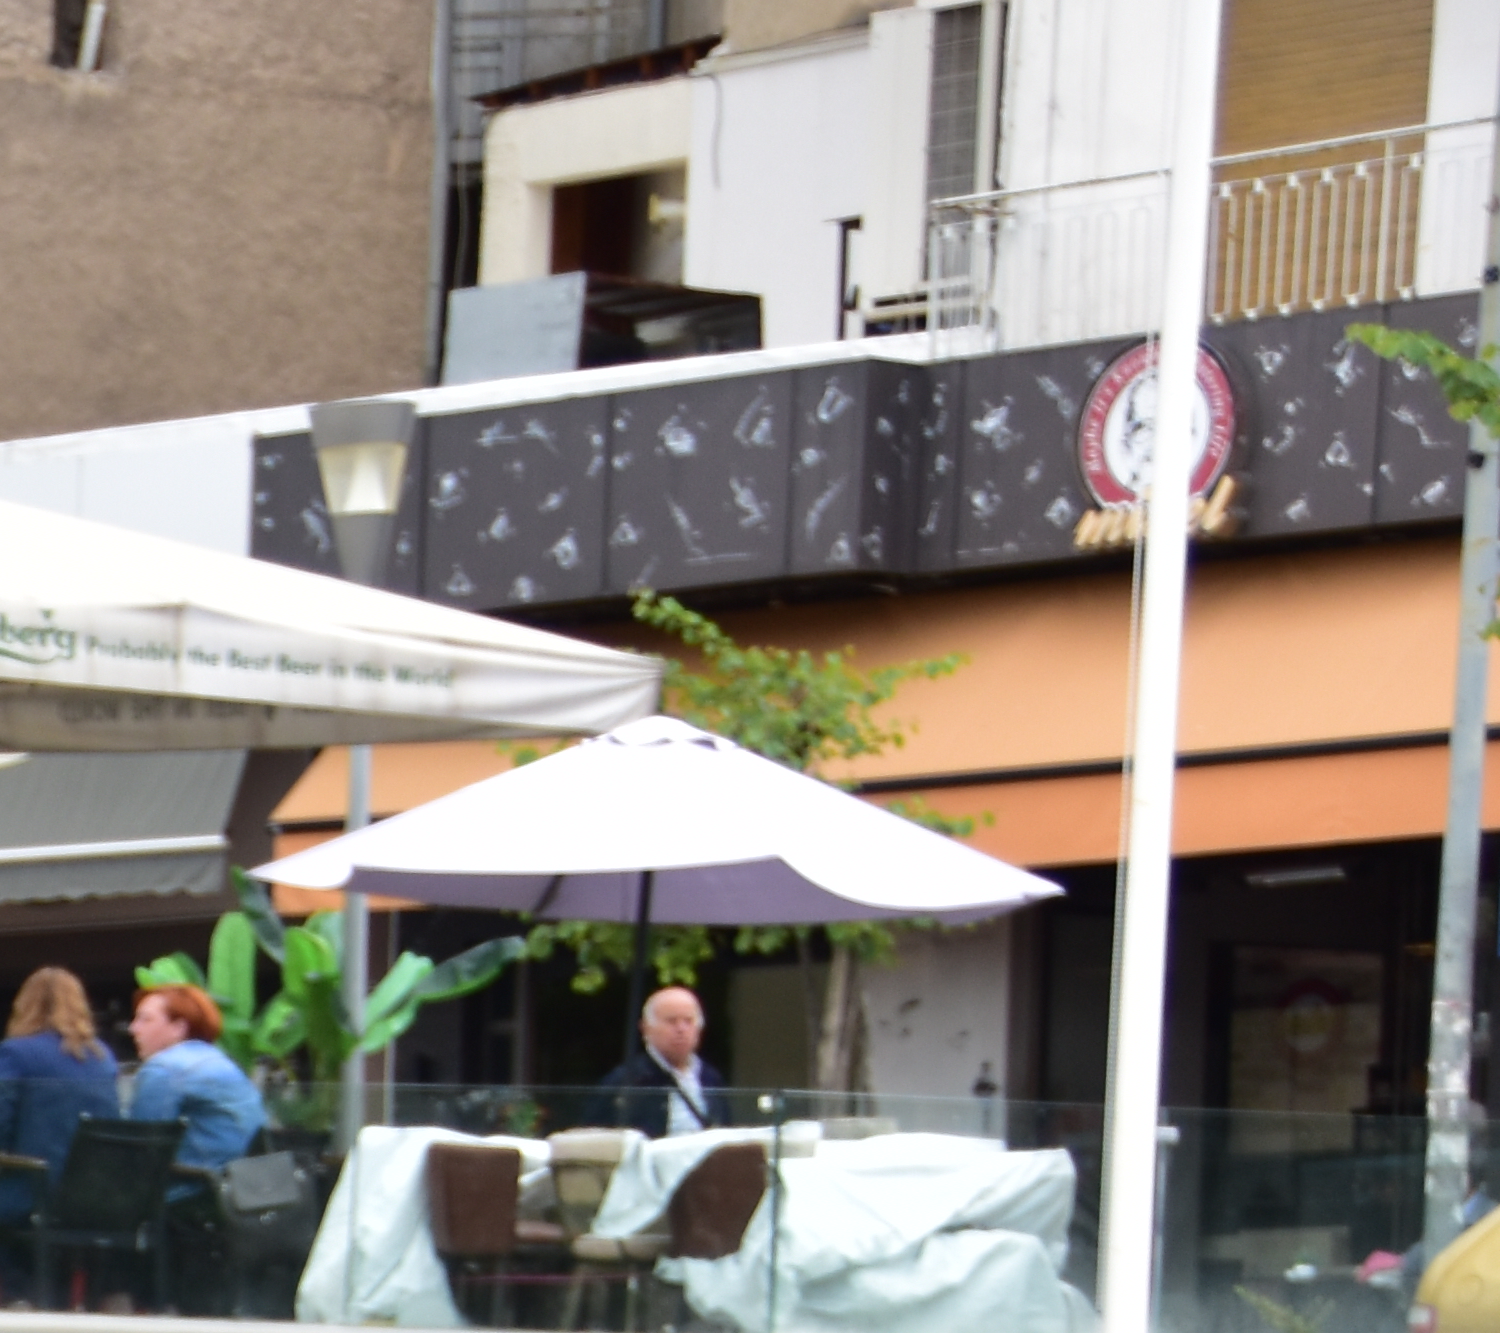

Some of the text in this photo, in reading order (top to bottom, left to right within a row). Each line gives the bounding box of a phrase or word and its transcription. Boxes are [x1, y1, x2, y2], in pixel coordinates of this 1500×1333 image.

[86, 634, 457, 689] Probably the Best Beer in the World
